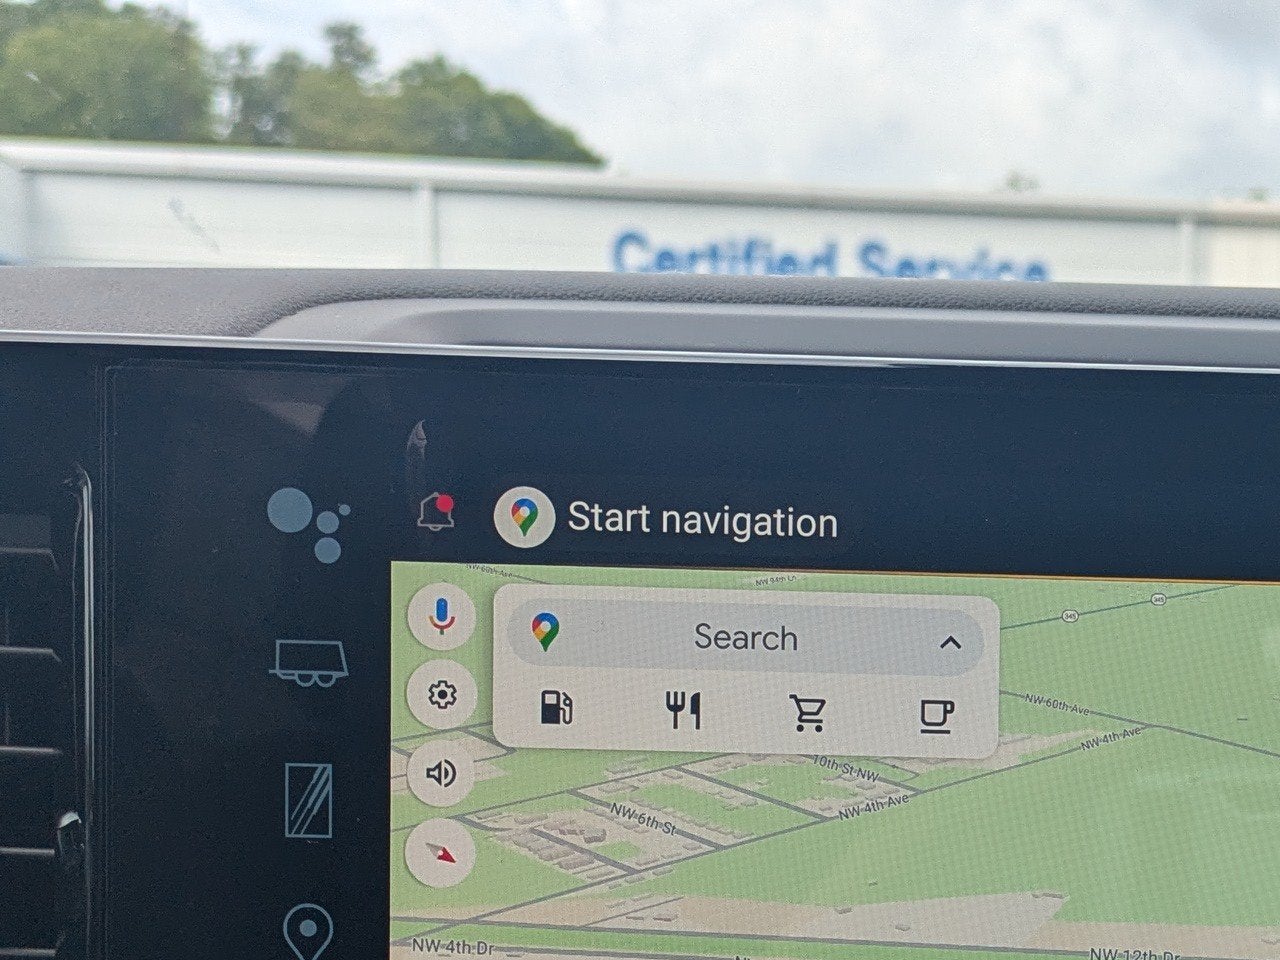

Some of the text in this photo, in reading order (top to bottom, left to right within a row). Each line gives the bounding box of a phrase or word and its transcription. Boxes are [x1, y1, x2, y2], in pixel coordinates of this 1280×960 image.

[612, 229, 1048, 281] Certified Service
[568, 500, 838, 543] Start navigation
[695, 623, 798, 652] Search
[1025, 693, 1090, 716] NW 60th Ave
[1080, 726, 1142, 751] NW 4th Ave
[813, 754, 880, 783] 10th St NW
[610, 801, 678, 837] NW 6th St
[838, 793, 910, 822] NW 4th Ave
[411, 938, 495, 957] NW 4th Dr
